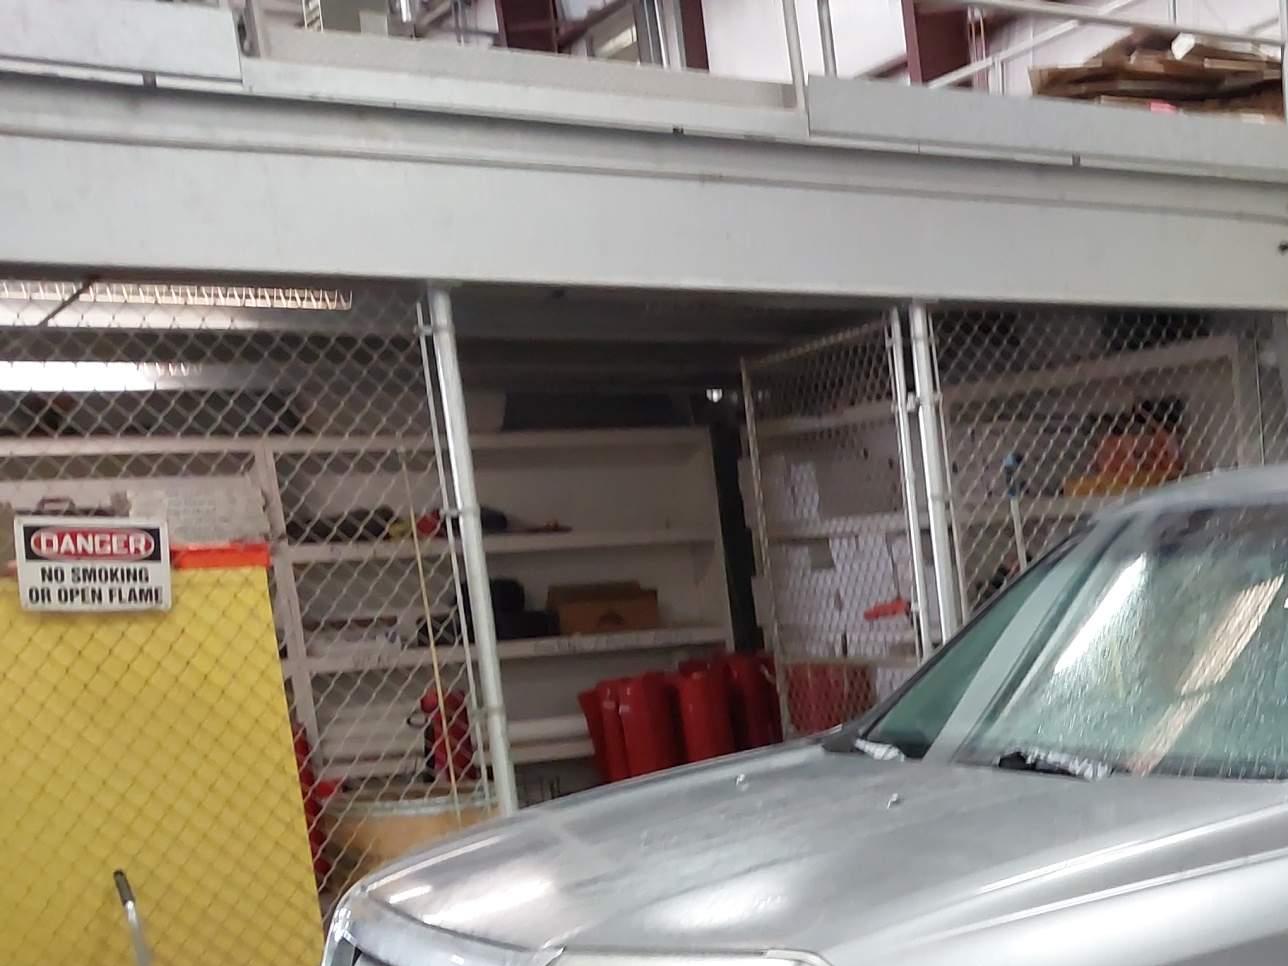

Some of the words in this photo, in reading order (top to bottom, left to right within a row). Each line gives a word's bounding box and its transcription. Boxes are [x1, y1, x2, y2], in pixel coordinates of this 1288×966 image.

[40, 533, 146, 554] DANGER
[40, 567, 65, 583] NO
[71, 567, 149, 583] SMOKING
[29, 587, 53, 604] OR
[58, 587, 103, 604] OPEN
[108, 587, 163, 604] FLAME
